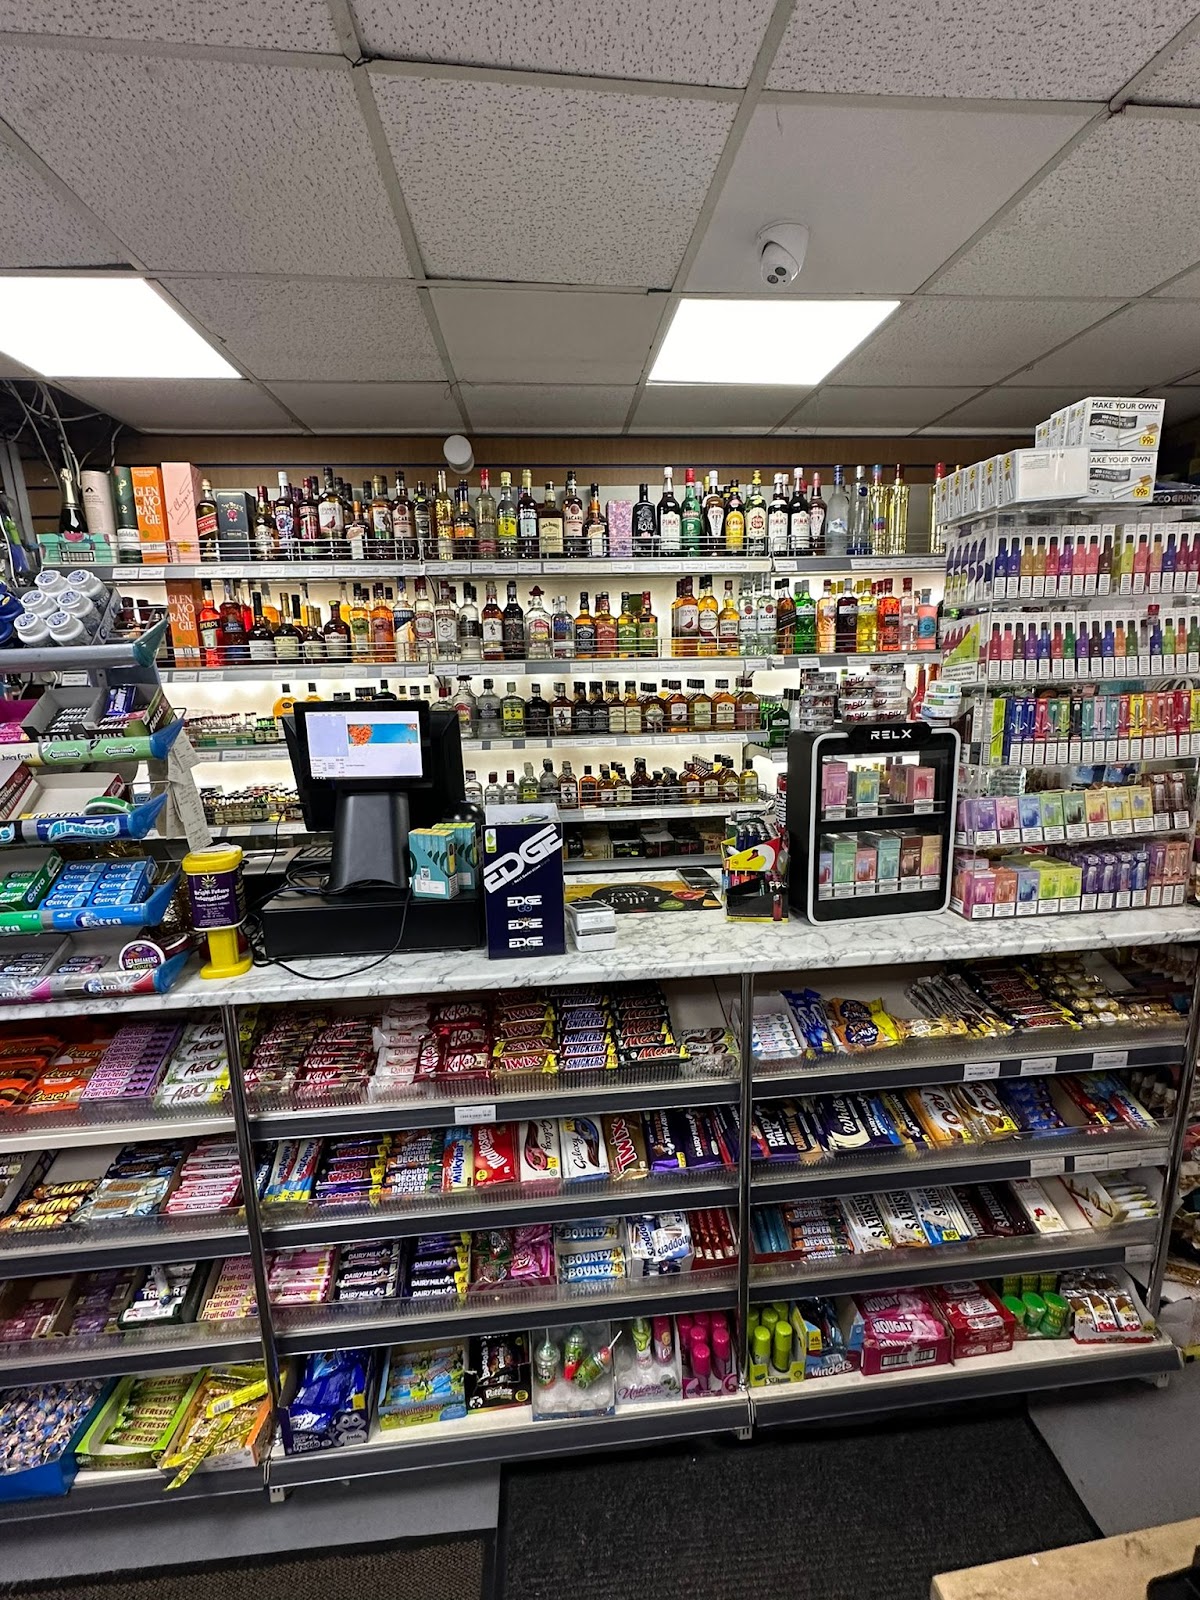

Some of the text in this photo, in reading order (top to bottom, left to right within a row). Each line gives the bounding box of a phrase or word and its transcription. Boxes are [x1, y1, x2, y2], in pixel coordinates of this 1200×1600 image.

[1142, 436, 1154, 445] 99p
[135, 487, 158, 497] GLEN
[143, 496, 161, 506] MO
[1172, 494, 1200, 503] GRIND
[136, 505, 156, 515] RAN
[145, 514, 161, 524] GIE
[168, 595, 193, 604] GLEN
[177, 604, 194, 613] MO
[170, 613, 190, 622] RAN
[179, 621, 195, 631] GIE
[100, 713, 129, 723] HALLS
[150, 706, 163, 732] HALLS
[98, 721, 129, 730] HALLS
[37, 734, 87, 742] HALLS
[871, 729, 912, 740] RELX
[50, 820, 116, 838] Airwaves
[484, 823, 562, 893] EDGE
[27, 878, 45, 902] extra
[507, 895, 542, 907] EDGE
[81, 916, 122, 927] Extra
[508, 918, 543, 930] EDGE
[509, 936, 543, 948] EDGE
[135, 956, 157, 965] BREAKERS
[88, 983, 117, 992] Extra
[568, 1019, 604, 1028] SNICKERS
[565, 1033, 603, 1042] SNICKERS
[567, 1045, 605, 1054] SNICKERS
[447, 1054, 475, 1072] KitKat
[502, 1056, 542, 1070] TWIX
[567, 1057, 605, 1068] SNICKERS
[834, 1098, 856, 1133] White
[890, 1094, 914, 1128] DAIRY MILK
[760, 1114, 777, 1147] DAIRY
[869, 1117, 879, 1136] DAIRY
[540, 1120, 552, 1150] Galaxy
[772, 1120, 787, 1146] MILK
[573, 1136, 587, 1169] Galaxy
[693, 1137, 704, 1157] DAIRY
[278, 1146, 290, 1180] Milkybar
[297, 1141, 315, 1178] Milkybar
[452, 1143, 464, 1184] Milkybar
[395, 1174, 428, 1182] DECKER
[892, 1192, 919, 1230] RSHEY'S
[978, 1185, 1009, 1227] HERSHEY'S
[854, 1195, 885, 1238] ERSHEY'S
[564, 1228, 607, 1238] BOUNTY
[802, 1226, 831, 1234] DECKER
[640, 1217, 655, 1256] noppers
[804, 1238, 834, 1246] DECKER
[658, 1237, 687, 1256] noppers
[568, 1252, 611, 1263] BOUNTY
[568, 1266, 612, 1276] BOUNTY
[143, 1288, 180, 1299] TRER
[216, 1284, 248, 1292] Fruit-tella
[206, 1299, 239, 1309] Fruit-tella
[865, 1295, 900, 1312] NOUGAT
[202, 1310, 235, 1319] Fruit-tella
[874, 1321, 913, 1333] NOUGAT
[811, 1362, 852, 1376] Windel's
[618, 1384, 660, 1399] Unicorn
[179, 1430, 219, 1478] STINGER
